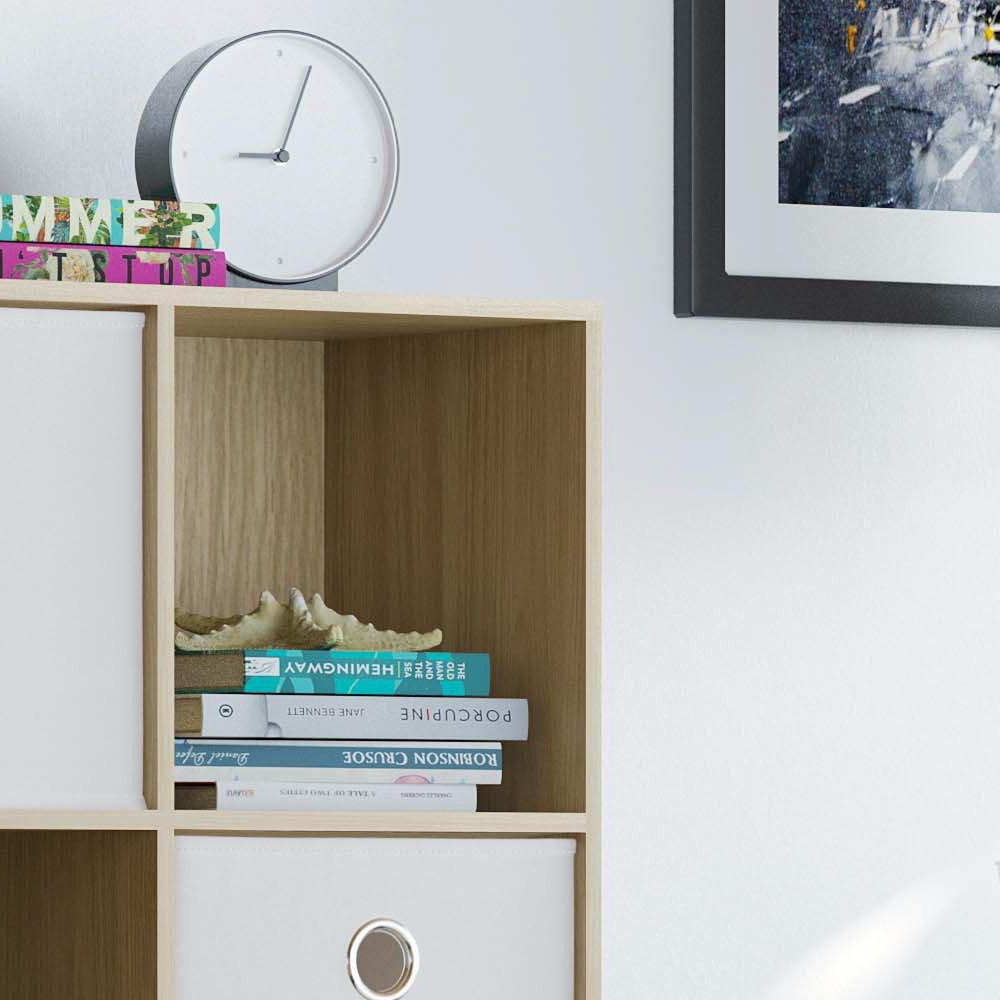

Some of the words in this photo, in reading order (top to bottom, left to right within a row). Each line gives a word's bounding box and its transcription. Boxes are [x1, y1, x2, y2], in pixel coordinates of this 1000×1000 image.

[93, 252, 211, 286] STOP
[283, 661, 394, 677] HEMINGWAY
[403, 662, 412, 678] SEA
[415, 661, 423, 679] THE
[425, 660, 433, 680] AND
[436, 661, 444, 680] MAN
[446, 661, 455, 680] OLD
[457, 662, 466, 680] THE
[287, 708, 336, 717] BENNETT
[338, 708, 366, 718] JANE
[400, 707, 512, 723] PORCUPINE
[207, 750, 250, 766] Daniel
[342, 751, 408, 765] CRUSOE
[414, 752, 498, 767] ROBINSON
